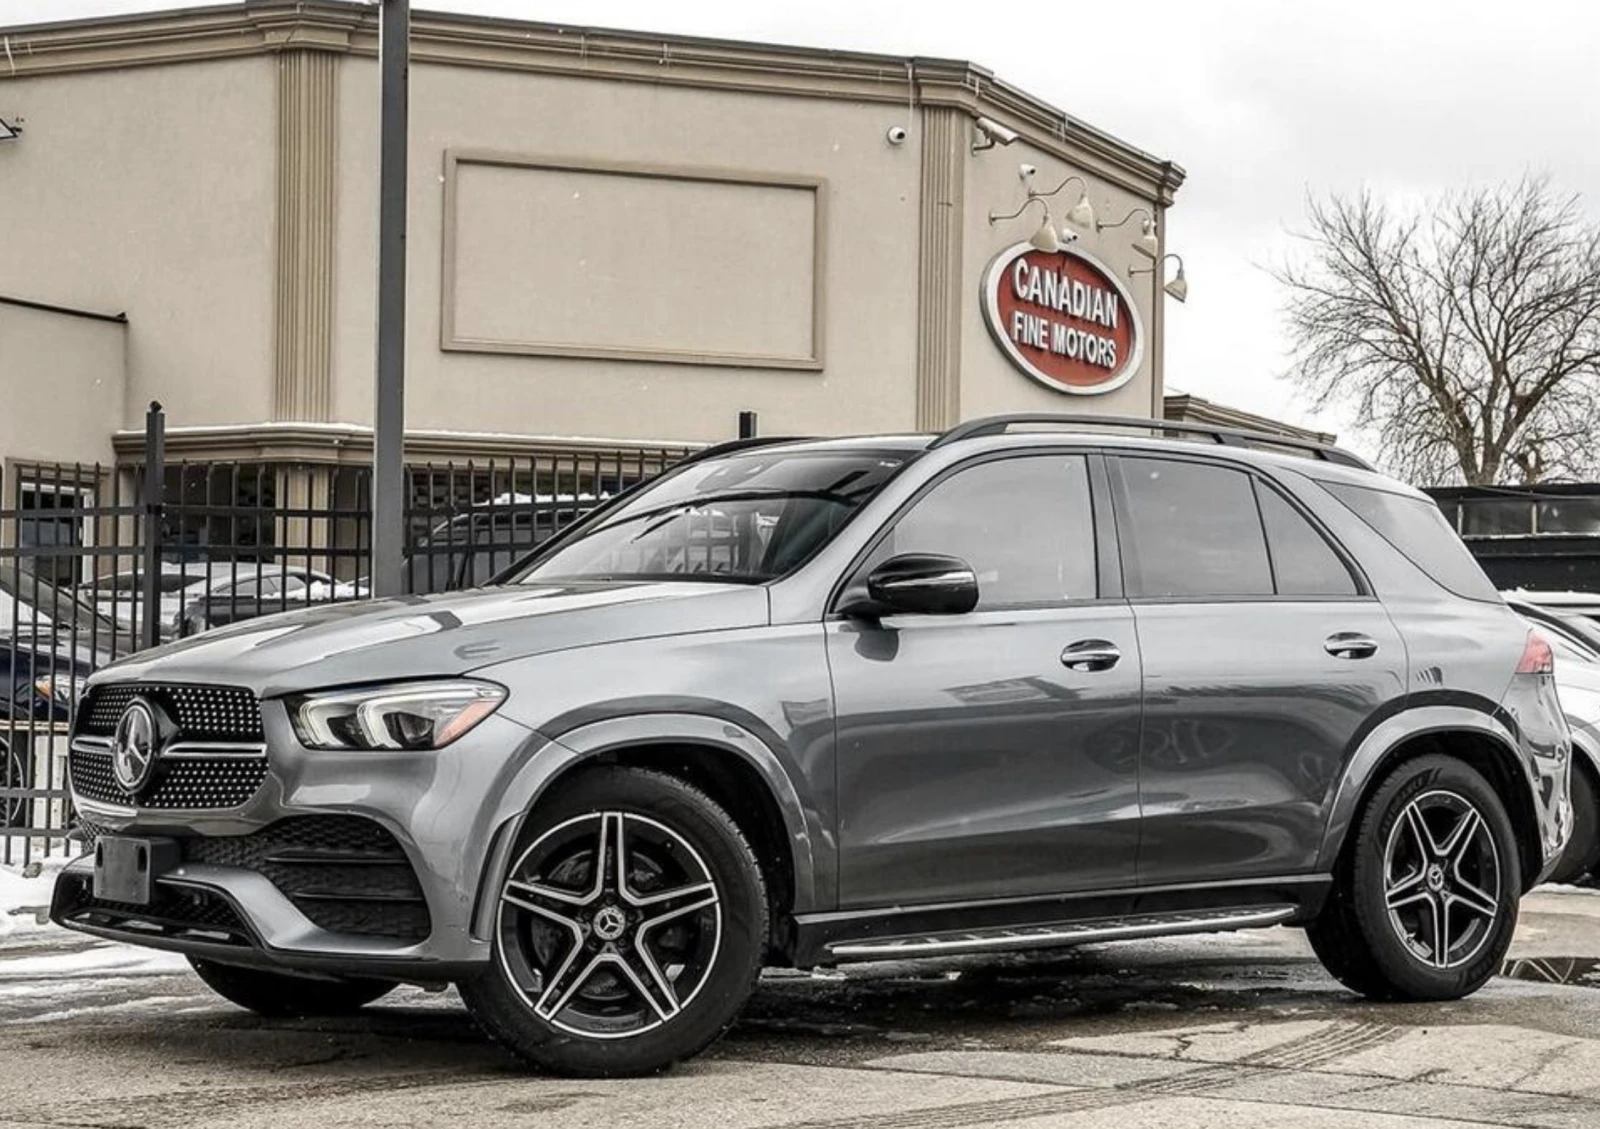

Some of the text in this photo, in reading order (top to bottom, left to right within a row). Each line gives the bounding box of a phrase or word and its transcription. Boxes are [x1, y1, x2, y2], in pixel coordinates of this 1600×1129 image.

[1014, 258, 1118, 329] CANADIAN
[1013, 311, 1117, 369] FINE MOTORS
